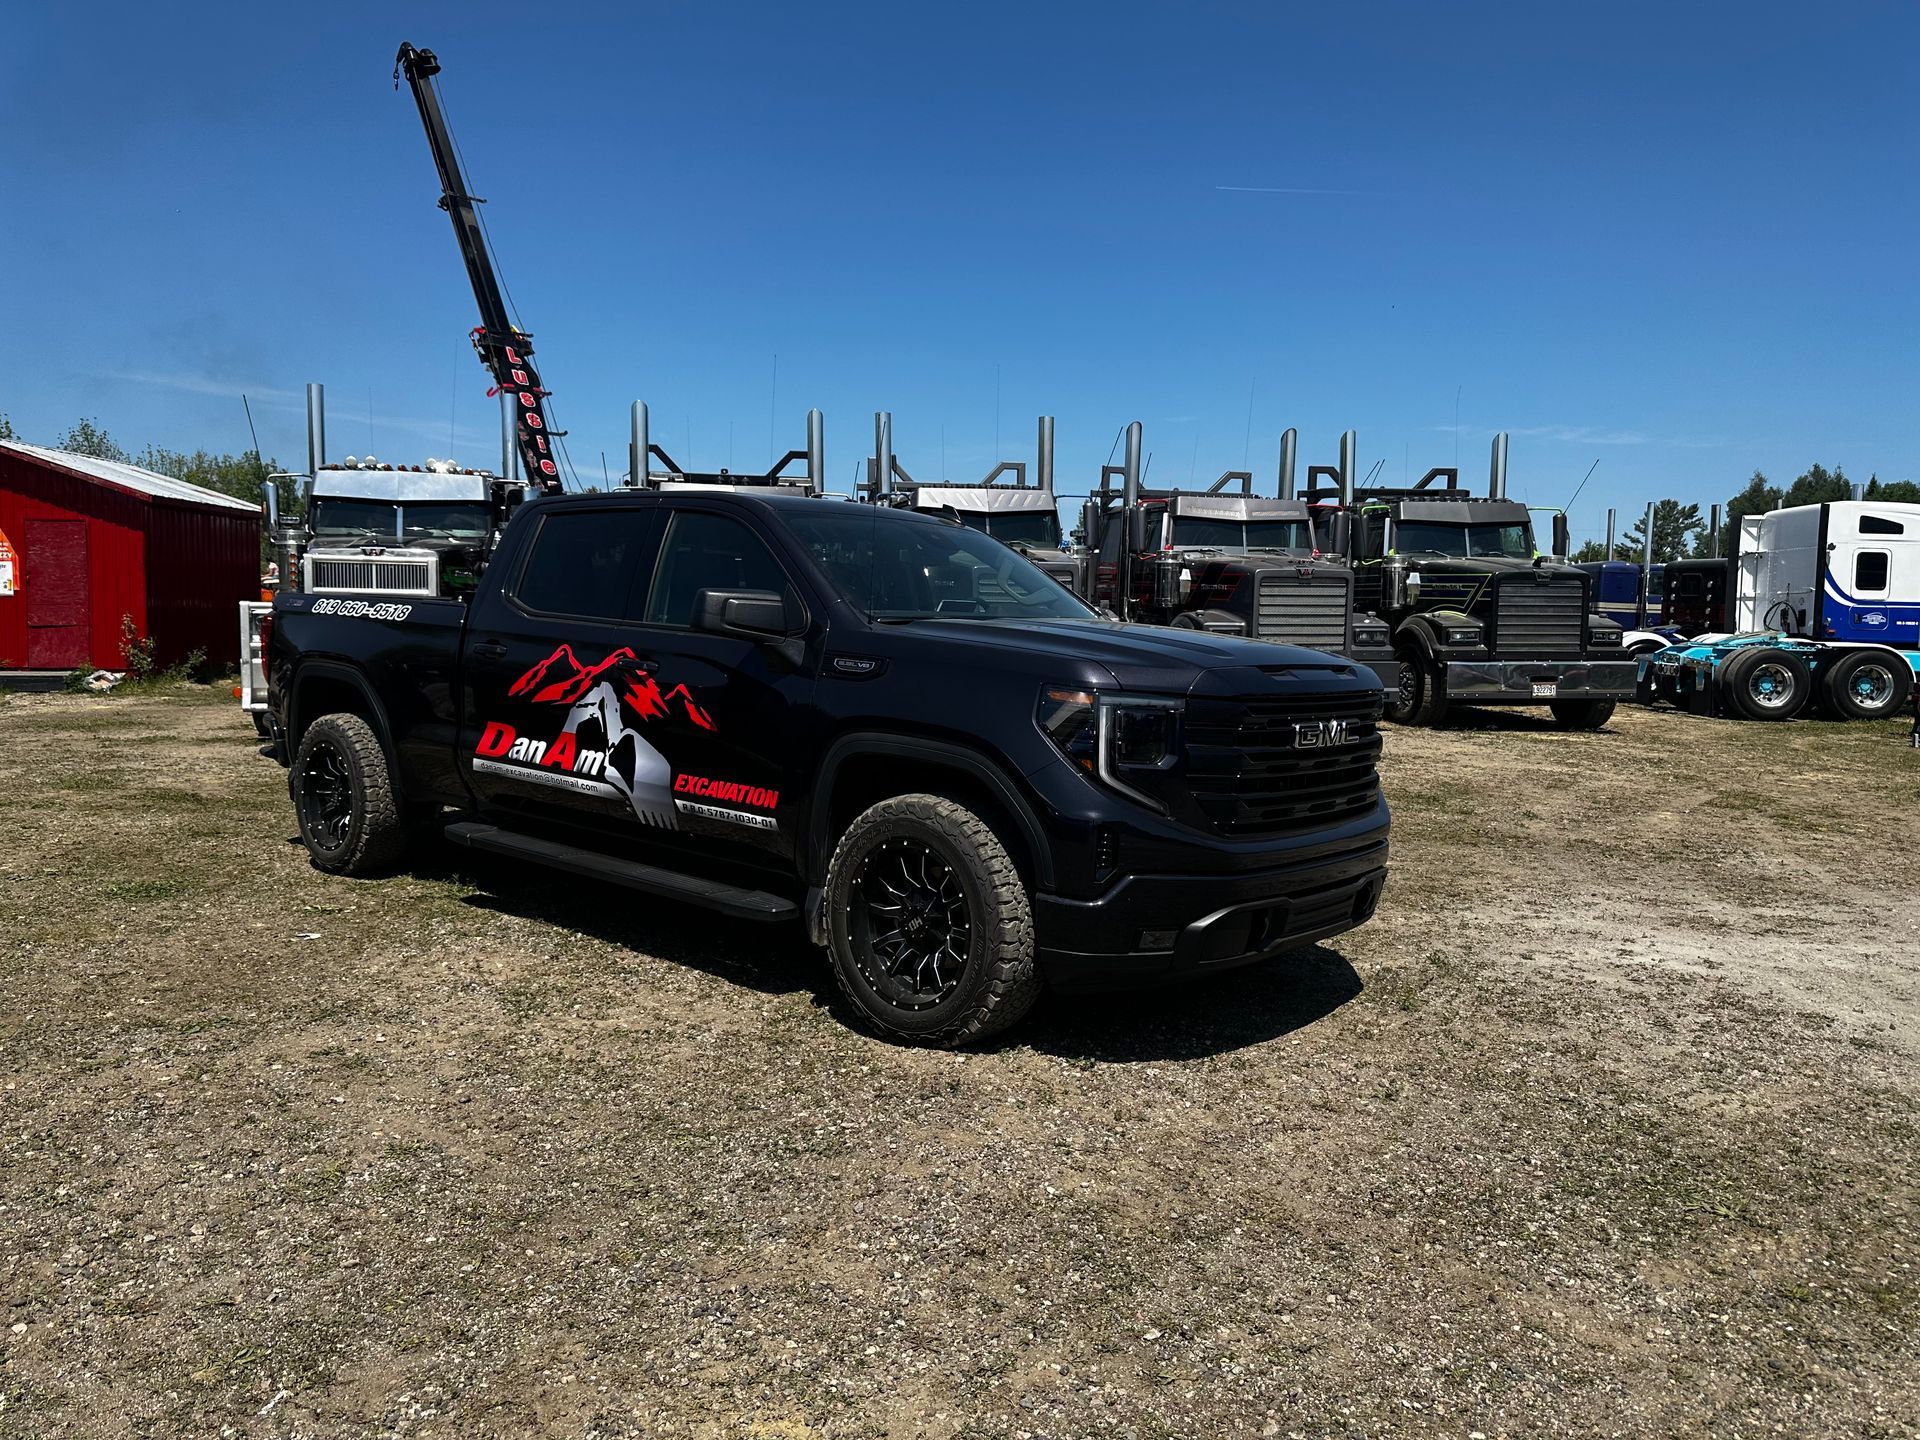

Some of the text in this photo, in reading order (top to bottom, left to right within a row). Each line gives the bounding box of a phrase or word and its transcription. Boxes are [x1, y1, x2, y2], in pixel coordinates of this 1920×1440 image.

[312, 599, 412, 621] 819 660-9518
[475, 721, 604, 776] DanAm
[1294, 719, 1360, 748] GMC
[674, 773, 779, 809] EXCAVATION
